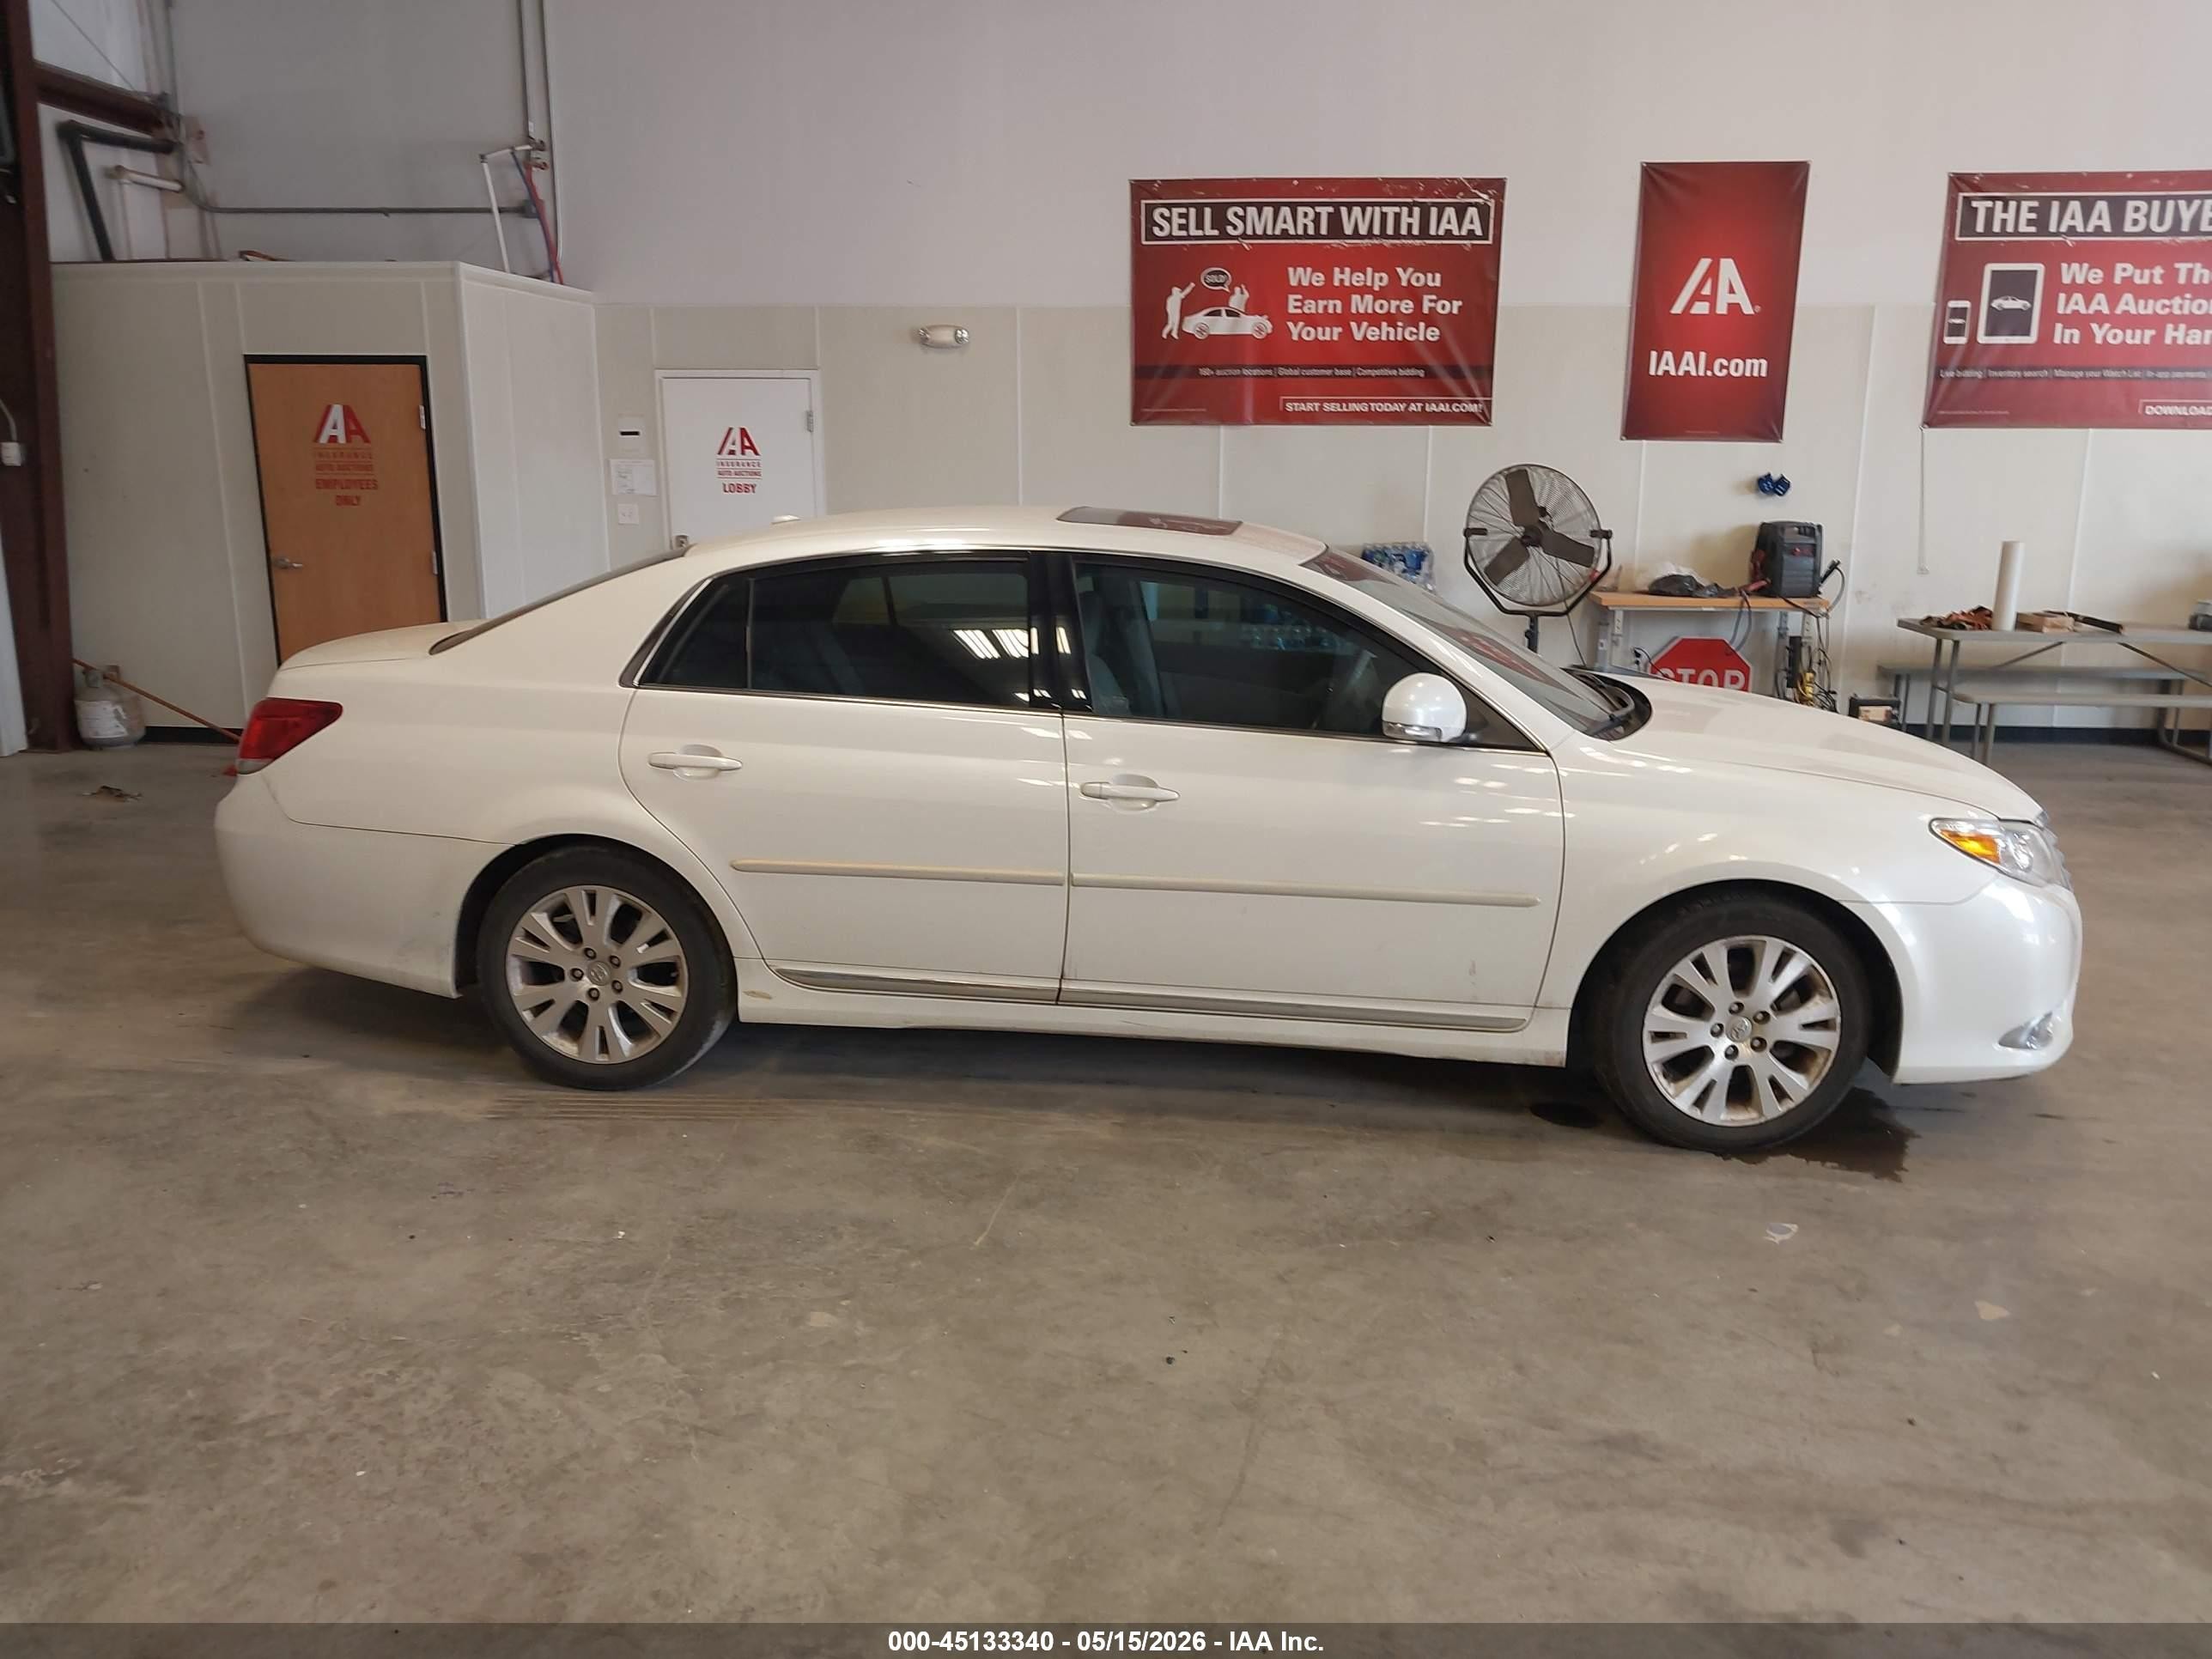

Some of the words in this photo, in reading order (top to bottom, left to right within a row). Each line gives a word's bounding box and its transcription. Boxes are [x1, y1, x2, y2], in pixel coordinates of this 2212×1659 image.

[1152, 206, 1220, 237] SELL
[1225, 206, 1335, 237] SMART
[1339, 206, 1421, 236] WITH
[1429, 206, 1485, 237] IAA
[1971, 200, 2040, 233] THE
[2048, 200, 2112, 233] IAA
[1287, 267, 1326, 287] We
[1333, 267, 1389, 290] Help
[1395, 266, 1443, 287] You
[2060, 263, 2104, 285] We
[2113, 263, 2166, 285] Put
[1287, 294, 1343, 314] Earn
[1350, 294, 1414, 315] More
[1421, 295, 1463, 315] For
[2057, 293, 2110, 315] IAA
[2114, 292, 2212, 315] Auctio
[1286, 321, 1344, 342] Your
[1350, 321, 1441, 342] Vehicle
[2053, 323, 2081, 345] In
[2089, 323, 2157, 345] Your
[1649, 350, 1768, 377] IAAI.com
[1285, 402, 1320, 412] START
[1322, 402, 1369, 412] SELLING
[1370, 403, 1407, 412] TODAY
[1407, 403, 1424, 412] AT
[722, 482, 757, 494] LOBBY
